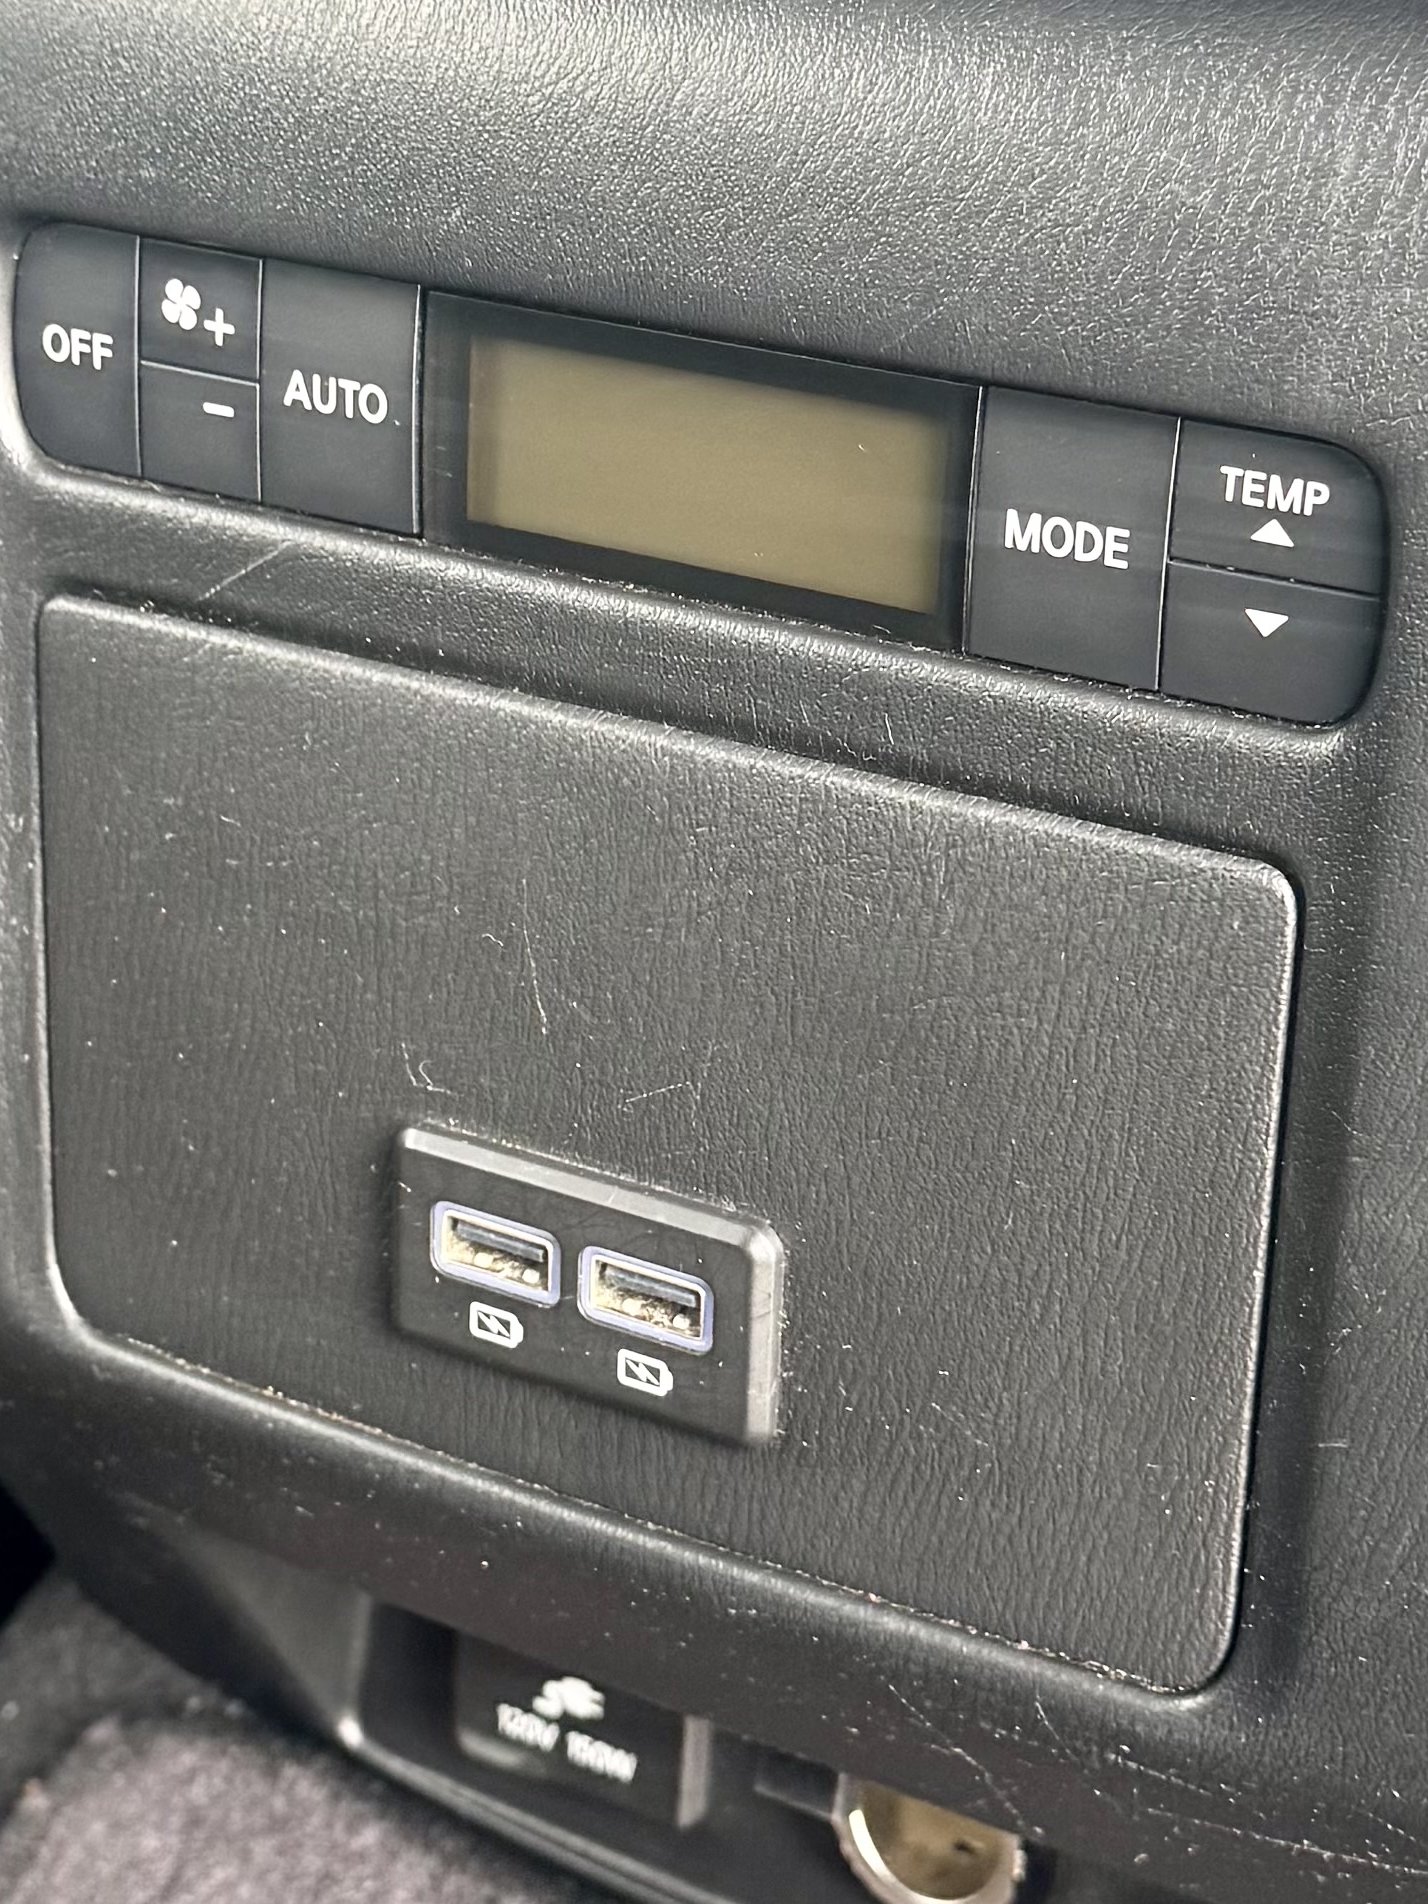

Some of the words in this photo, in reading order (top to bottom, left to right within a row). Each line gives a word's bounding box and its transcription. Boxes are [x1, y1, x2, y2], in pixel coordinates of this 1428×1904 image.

[41, 323, 114, 371] OFF
[282, 368, 388, 425] AUTO
[1219, 465, 1331, 517] TEMP
[1004, 508, 1131, 570] MODE
